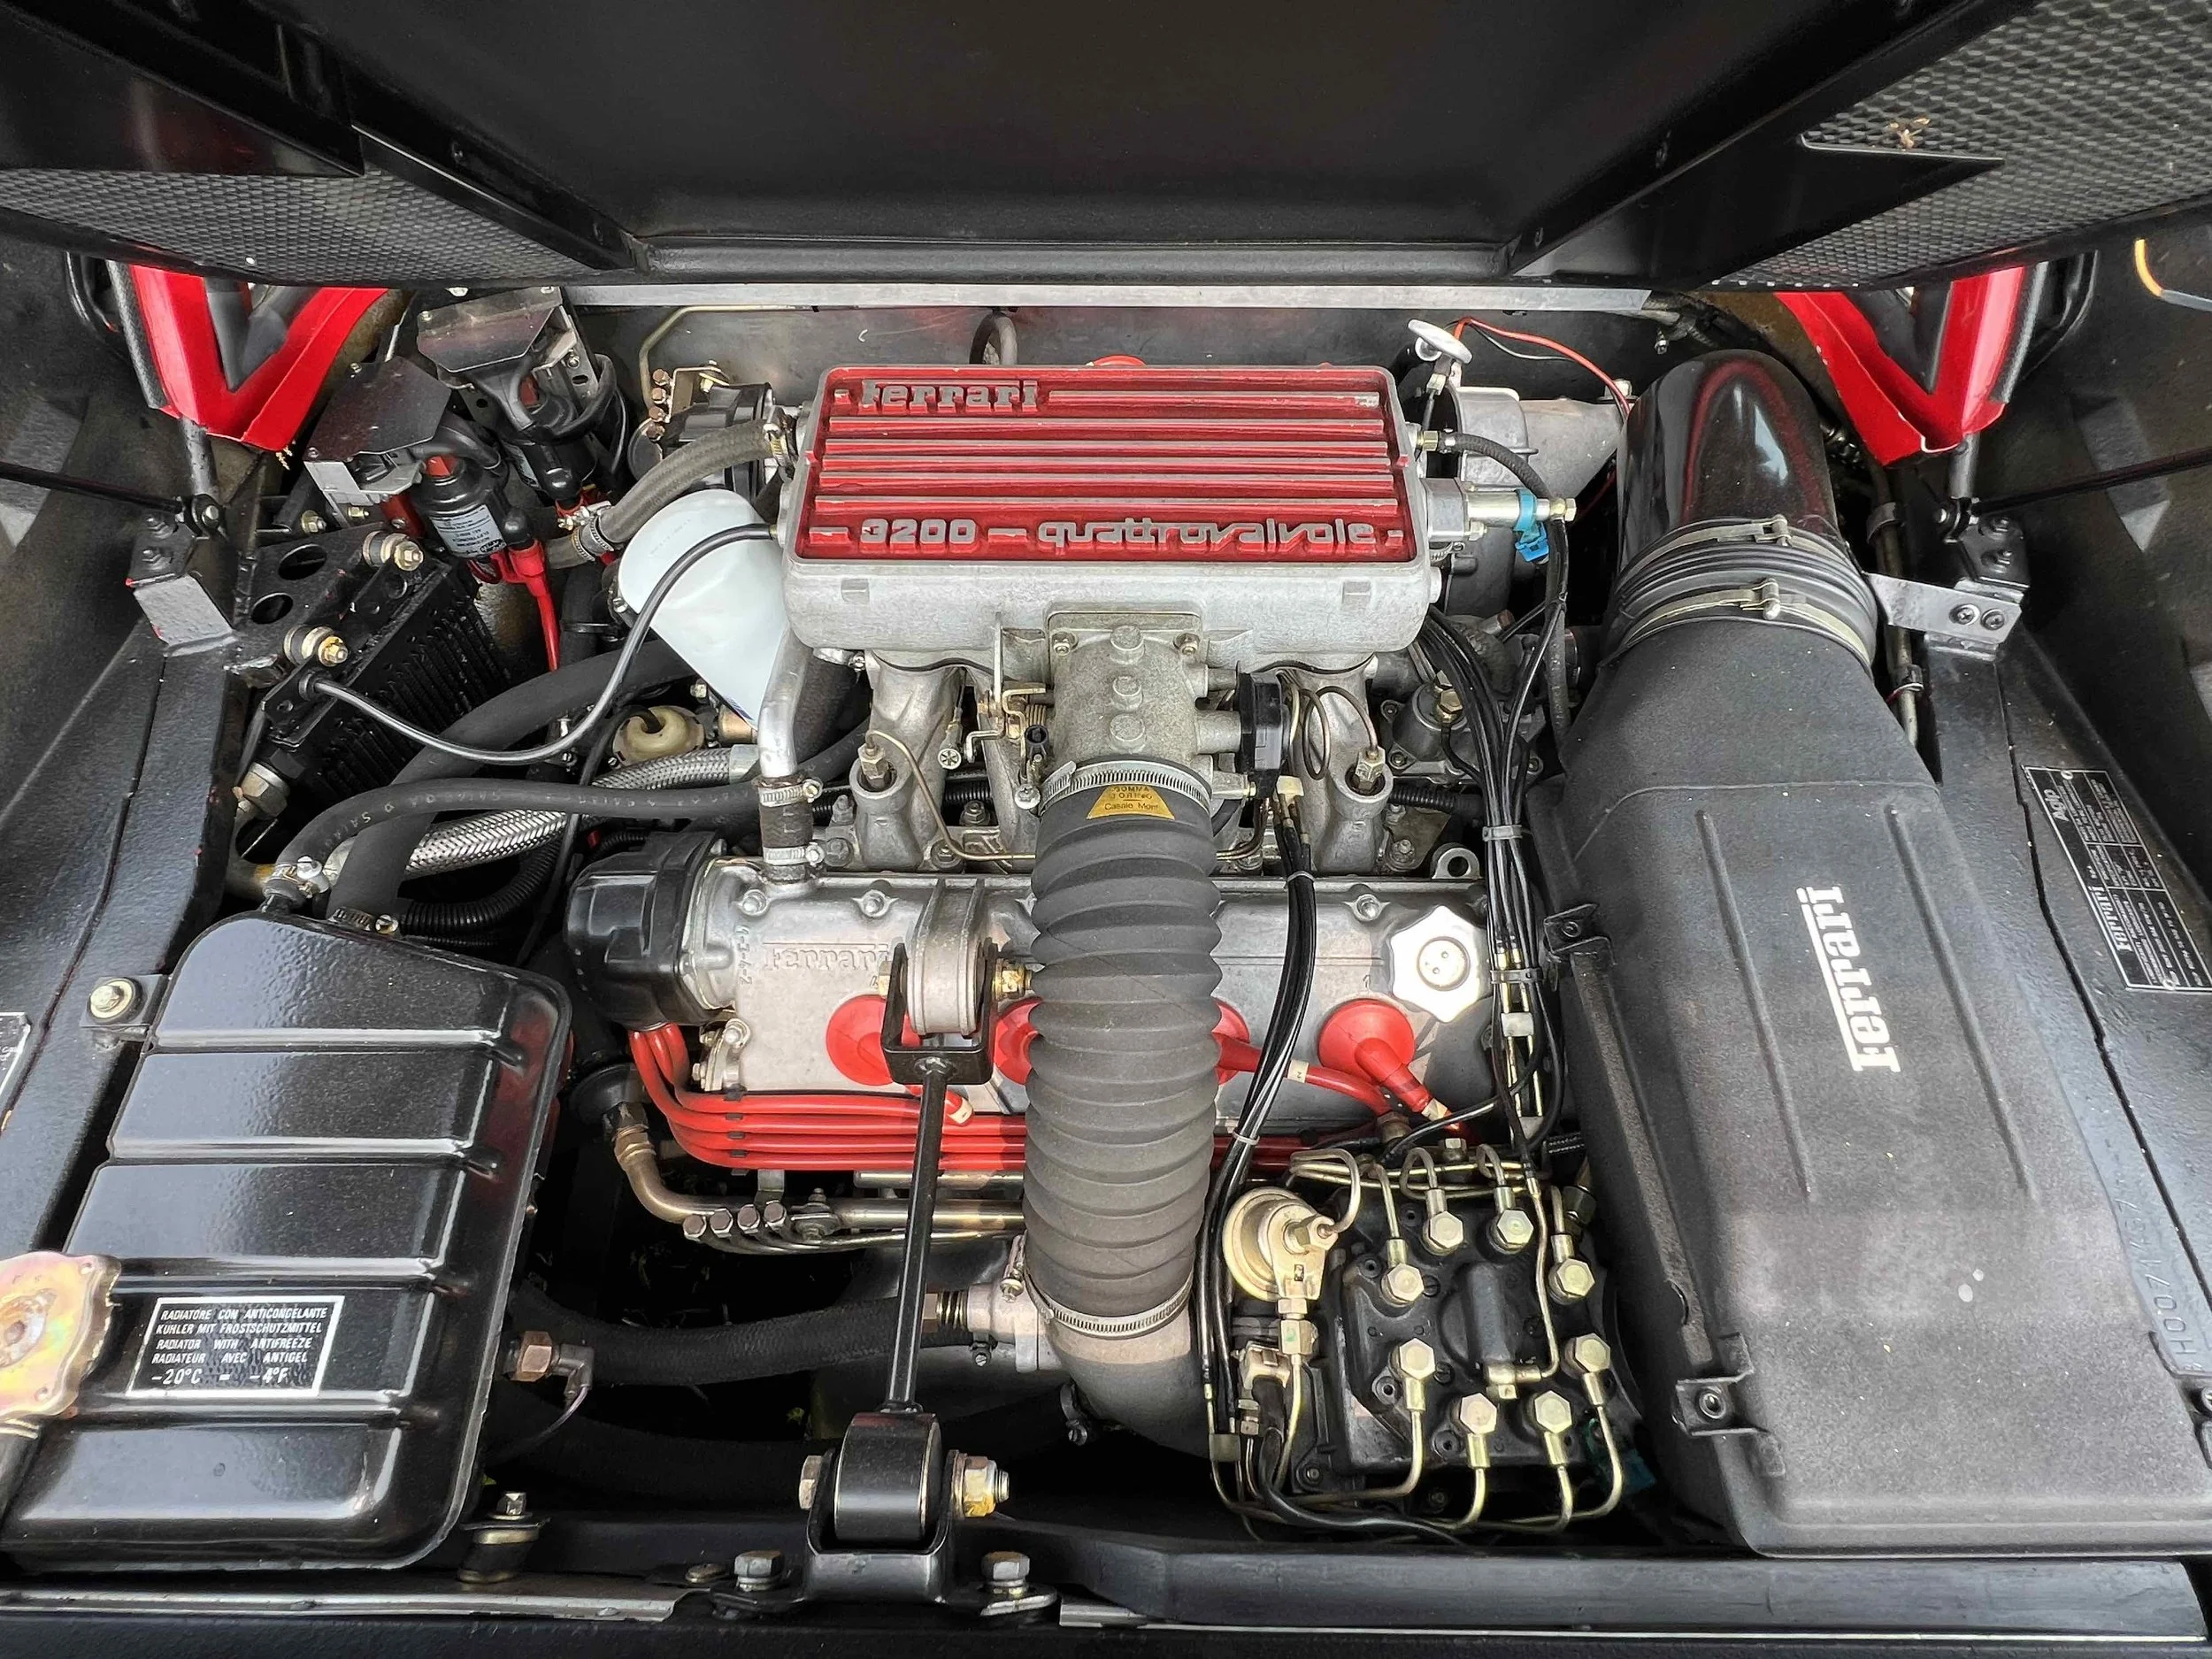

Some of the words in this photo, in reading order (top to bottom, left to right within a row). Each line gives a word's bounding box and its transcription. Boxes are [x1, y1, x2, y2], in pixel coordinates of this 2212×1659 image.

[860, 380, 1038, 410] Ferrari
[860, 518, 977, 545] 3200
[1038, 518, 1375, 547] quattrovalvole
[1796, 887, 1901, 1072] Ferrari
[160, 1309, 212, 1320] RADIATORE
[218, 1309, 240, 1320] CON
[243, 1307, 328, 1319] ANTICONGELANTE
[196, 1323, 216, 1334] MIT
[219, 1322, 322, 1334] FROSTSCHUTZMITTEL
[156, 1339, 202, 1350] RADIATOR
[214, 1339, 239, 1350] WITH
[250, 1337, 312, 1349] ANTIFREEZE
[151, 1352, 206, 1364] RADIATEUR
[221, 1352, 249, 1363] AVEC
[262, 1351, 308, 1363] ANTIGEL
